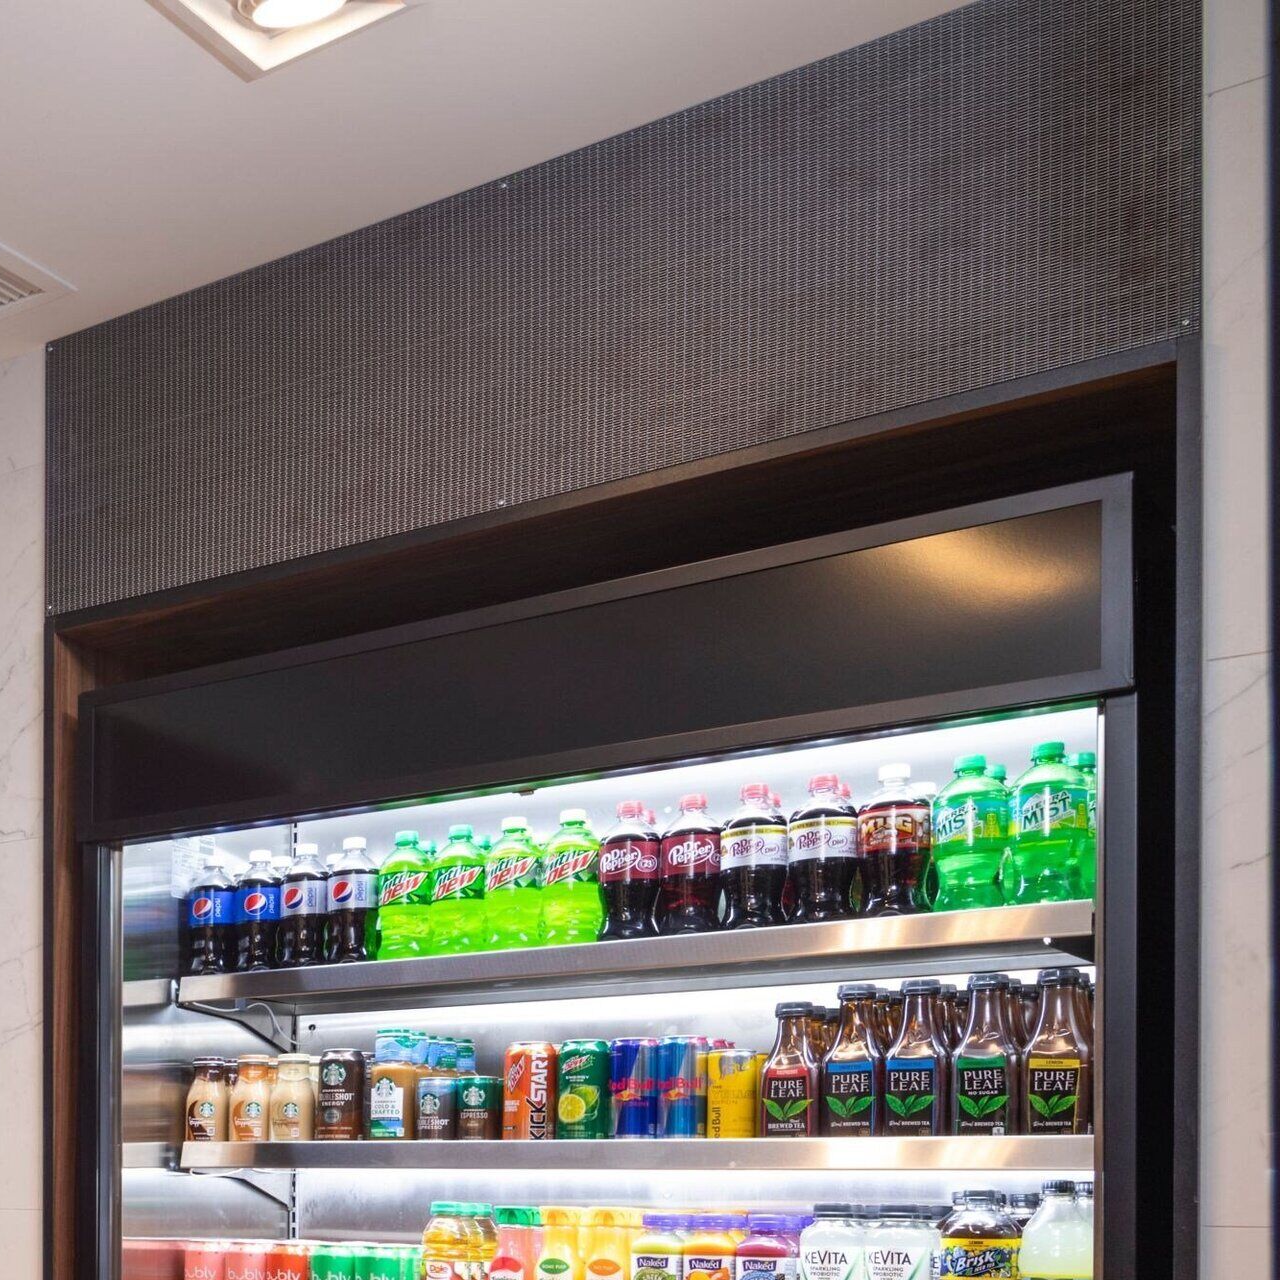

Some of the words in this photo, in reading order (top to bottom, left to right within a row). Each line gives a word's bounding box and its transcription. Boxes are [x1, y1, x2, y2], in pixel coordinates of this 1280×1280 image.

[610, 848, 627, 861] Dr
[670, 845, 712, 866] Pepper
[600, 853, 638, 873] Pepper
[832, 1073, 868, 1085] PURE
[890, 1071, 930, 1083] PURE
[964, 1069, 1003, 1081] PURE
[1035, 1070, 1073, 1082] PURE
[771, 1079, 803, 1090] PURE
[832, 1083, 869, 1094] LEAF
[890, 1081, 930, 1092] LEAF
[964, 1079, 1003, 1090] LEAF
[771, 1088, 804, 1098] LEAF
[768, 1122, 792, 1130] BREWED
[639, 1258, 666, 1268] Naked
[805, 1251, 847, 1265] KEVITA
[869, 1251, 911, 1266] KEVITA
[430, 1264, 449, 1274] Dole
[691, 1260, 720, 1270] Naked
[745, 1261, 774, 1271] Naked
